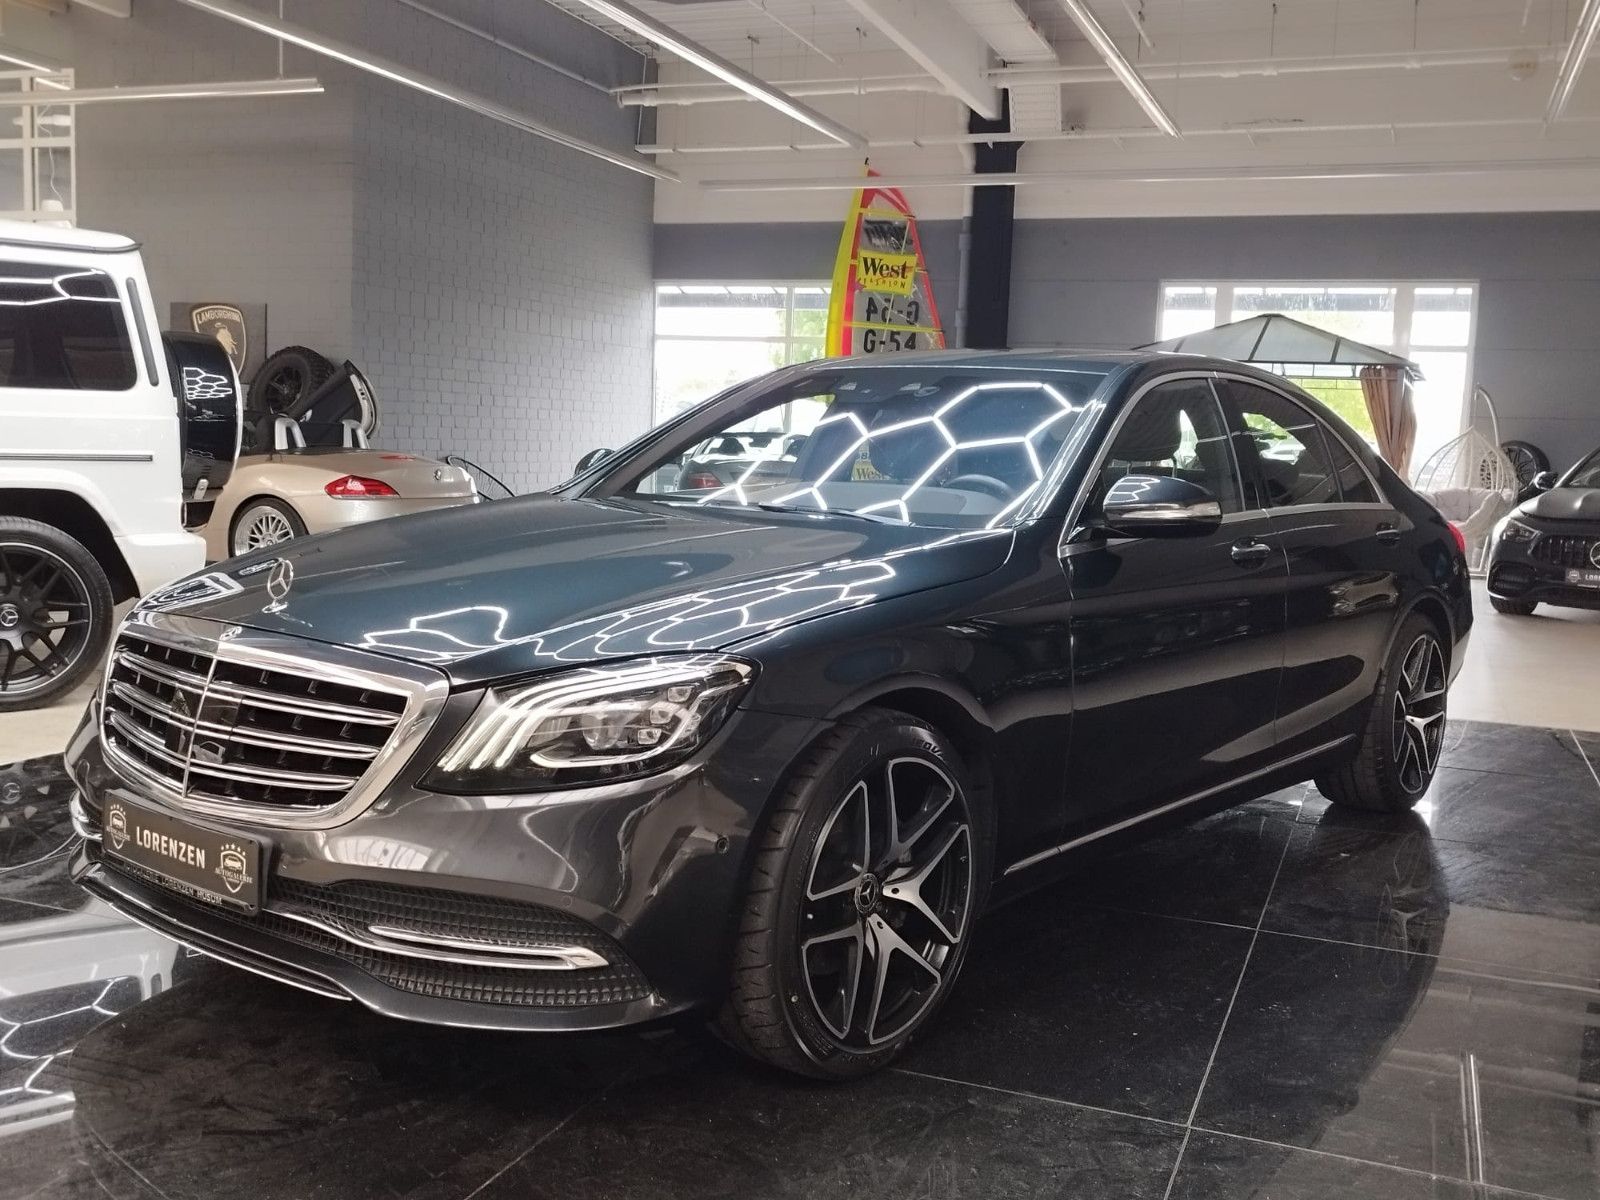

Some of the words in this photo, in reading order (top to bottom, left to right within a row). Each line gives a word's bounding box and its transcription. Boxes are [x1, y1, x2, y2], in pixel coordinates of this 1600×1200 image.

[863, 257, 908, 279] West
[863, 329, 917, 353] G-54
[856, 468, 882, 480] Wes
[136, 825, 206, 869] LORENZEN
